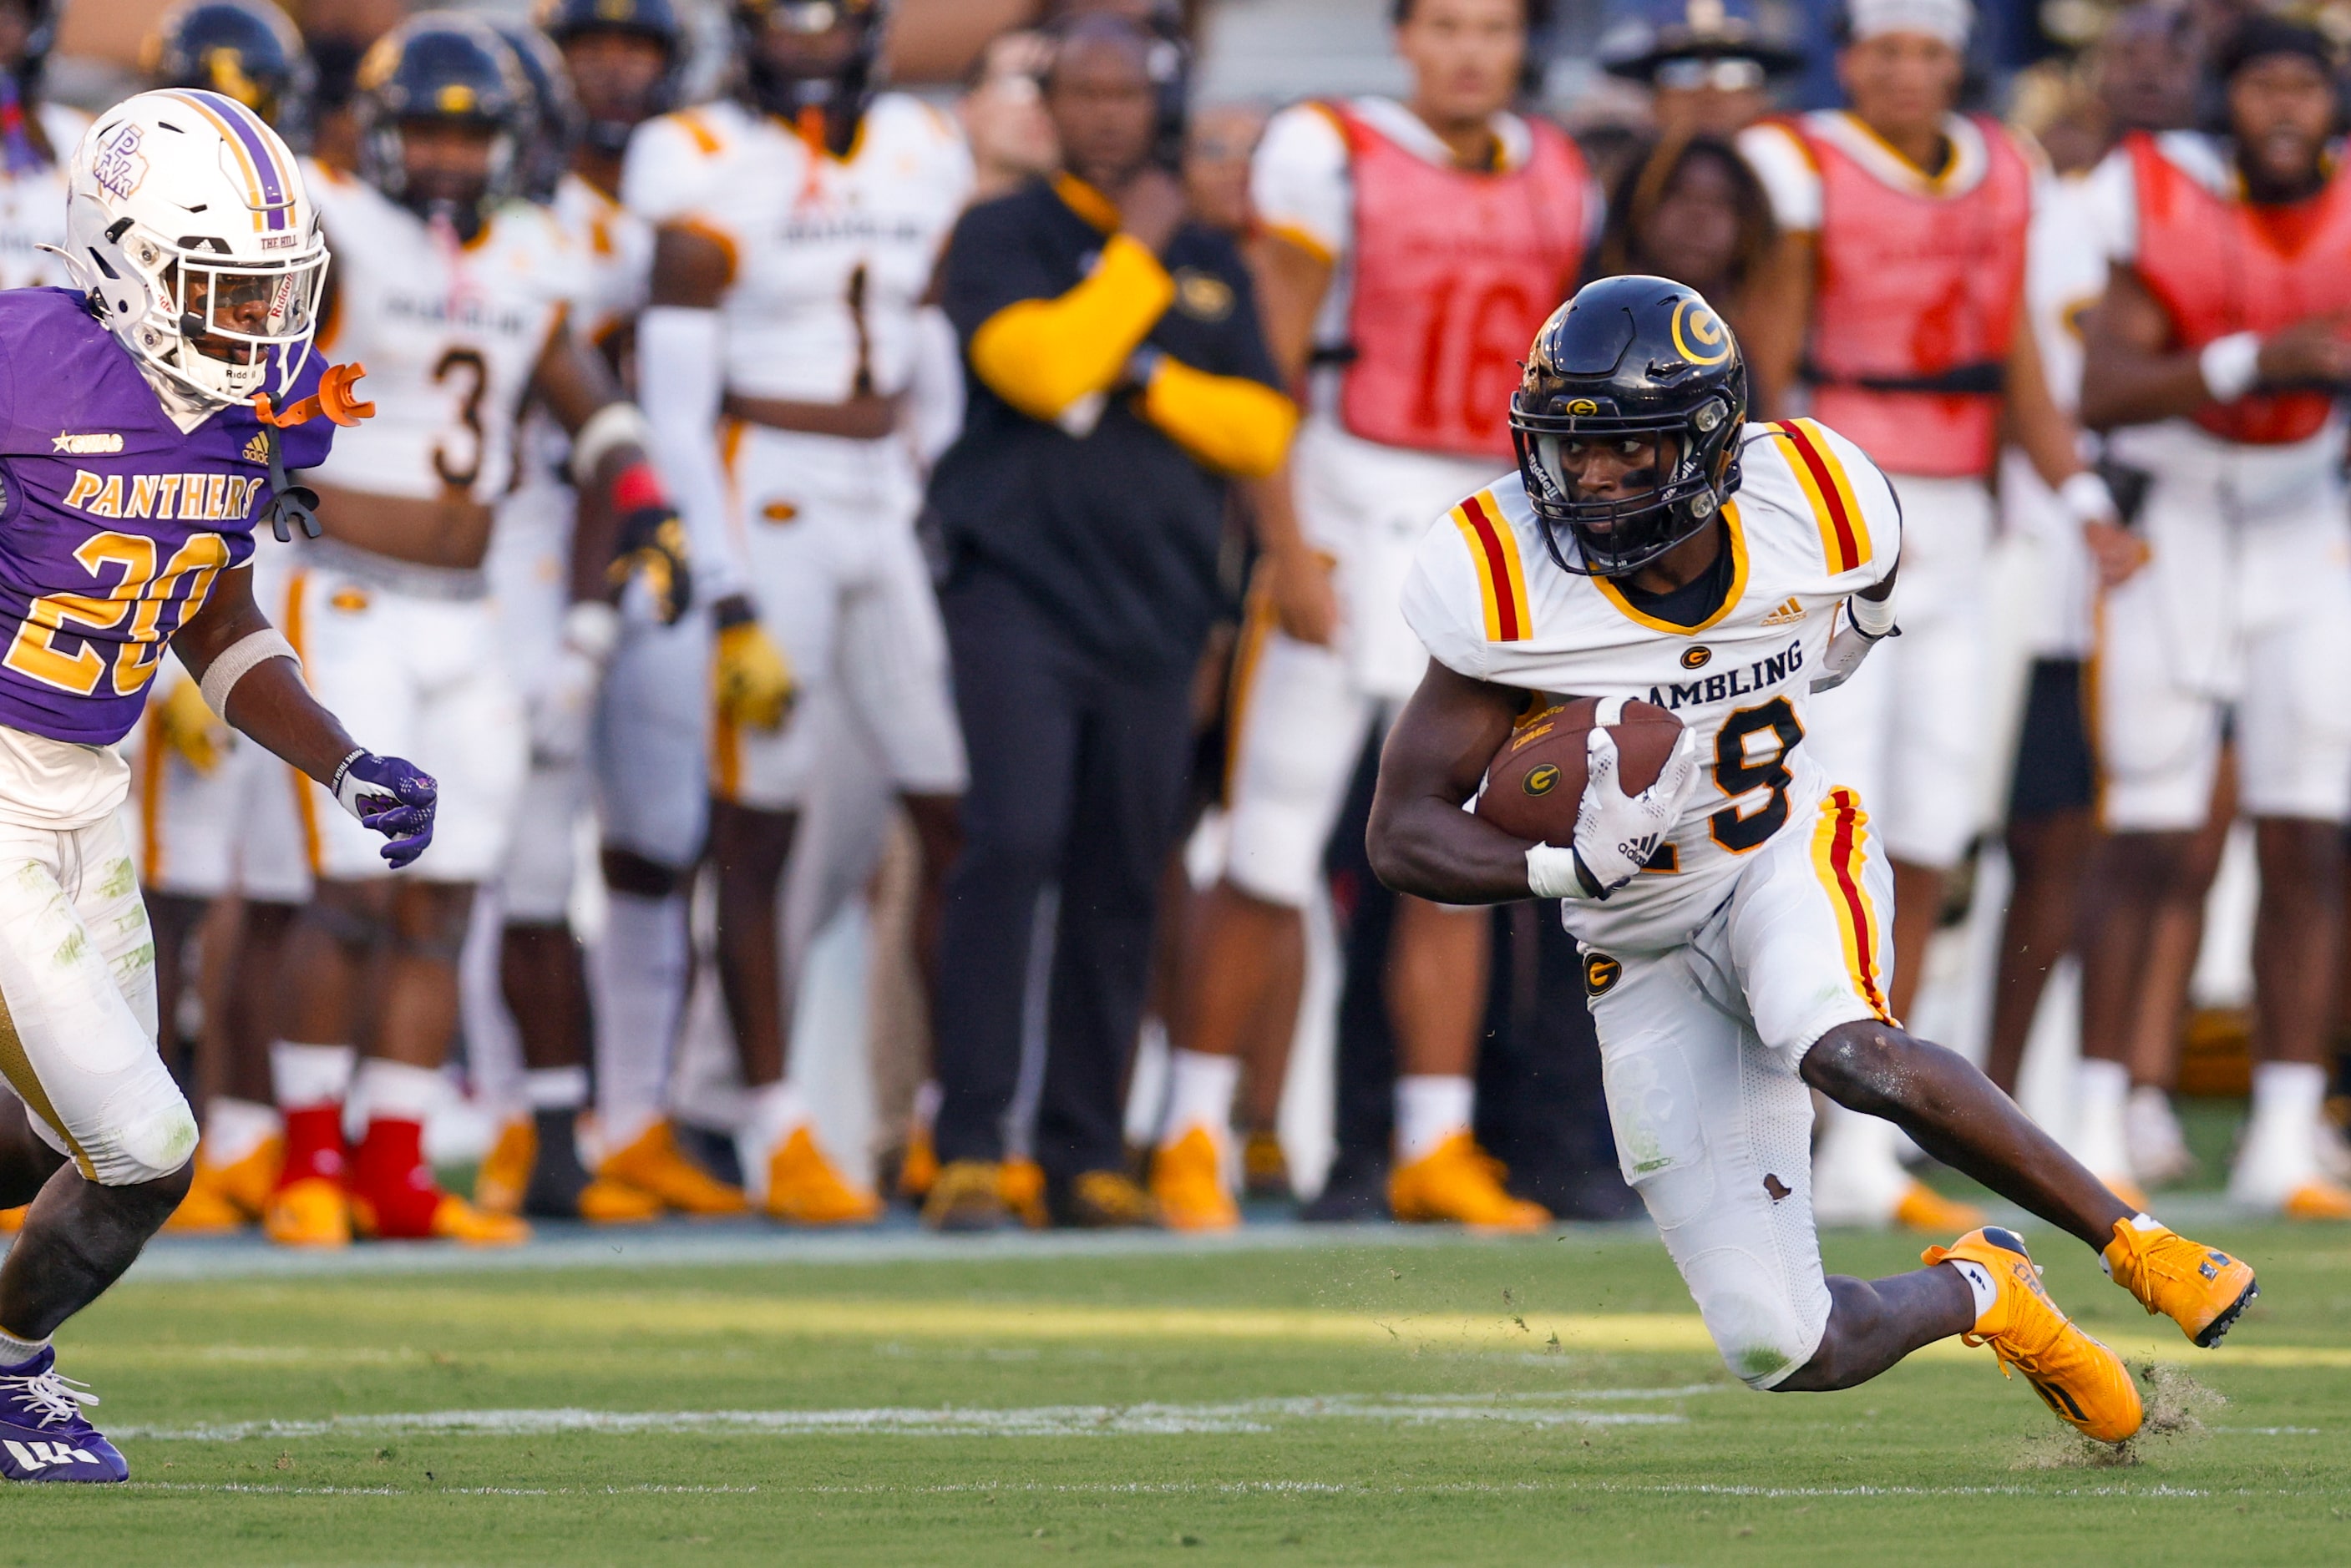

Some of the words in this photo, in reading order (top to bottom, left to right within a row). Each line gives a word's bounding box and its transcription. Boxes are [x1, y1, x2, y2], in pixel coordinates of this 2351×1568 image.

[261, 237, 279, 250] THE
[280, 235, 297, 248] HILL
[226, 369, 256, 379] Riddll
[429, 344, 489, 486] 3
[63, 469, 264, 521] PANTHERS
[2, 530, 231, 696] 20
[1760, 611, 1808, 627] adidas
[1629, 639, 1804, 711] AMBLING
